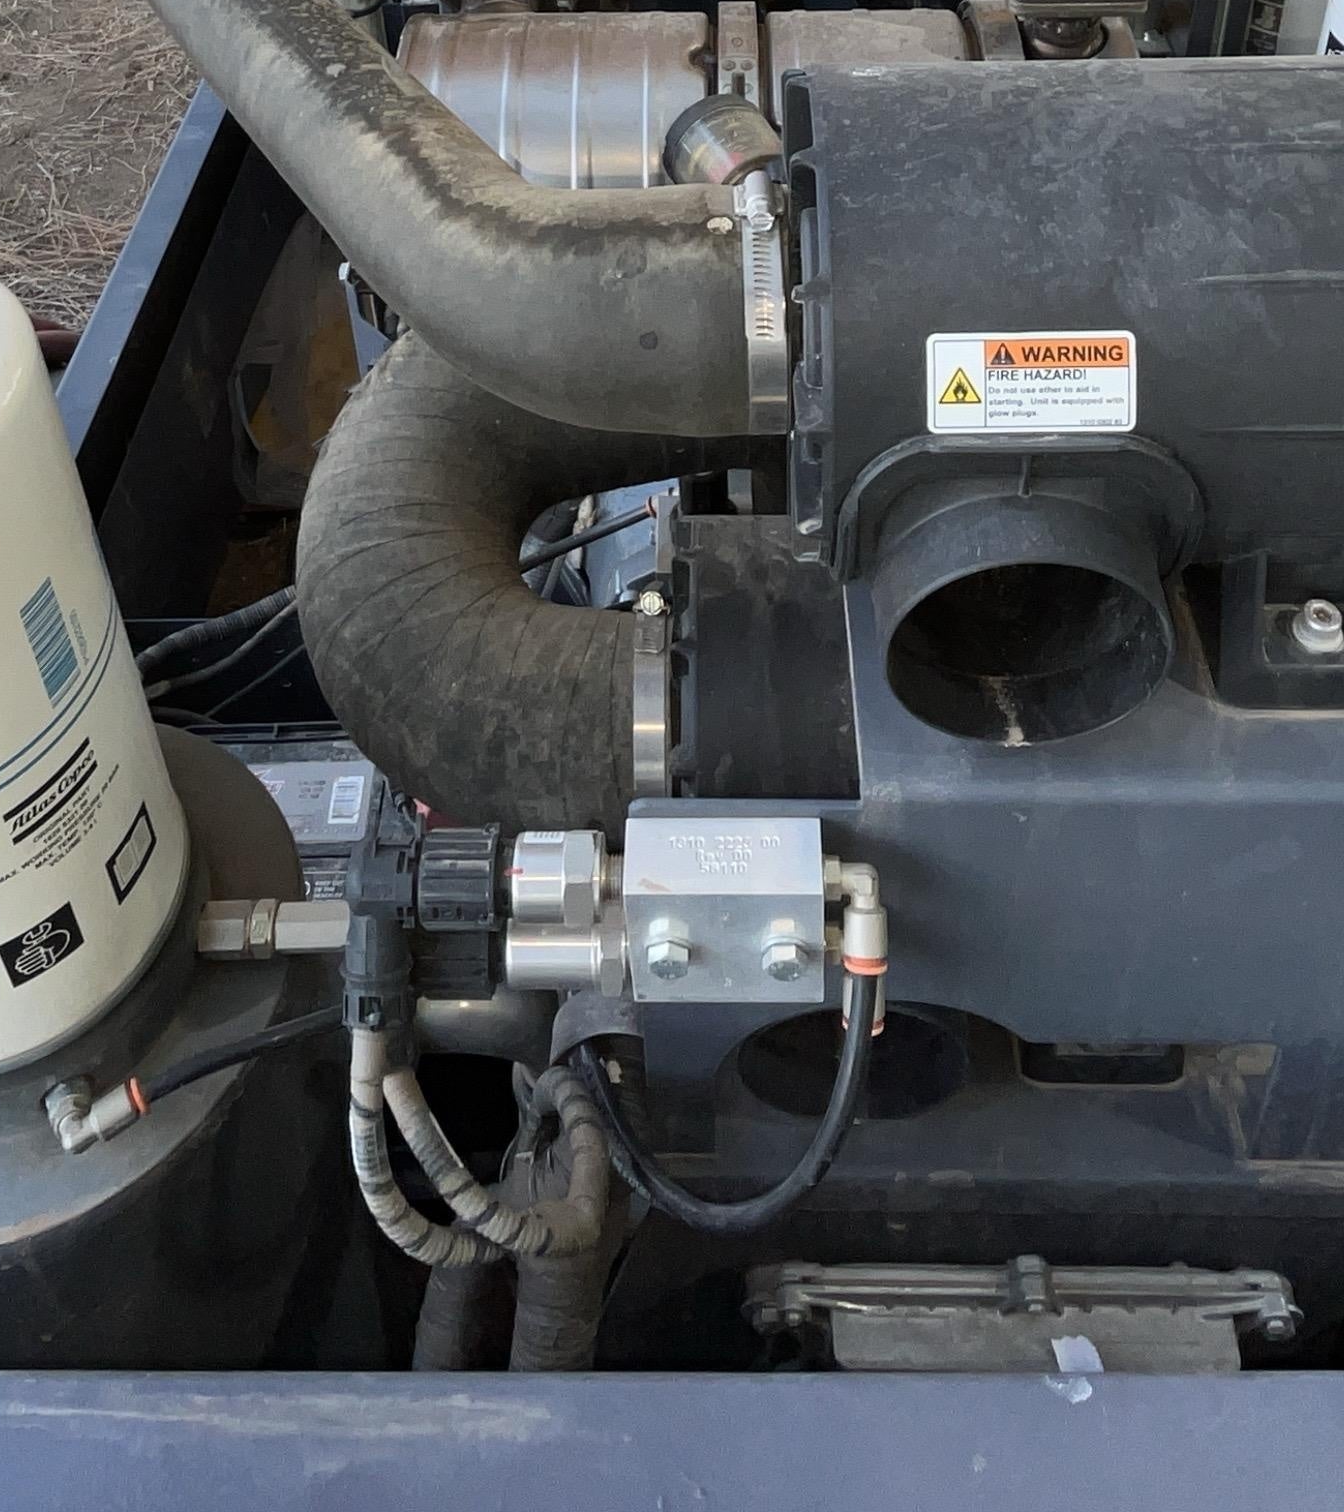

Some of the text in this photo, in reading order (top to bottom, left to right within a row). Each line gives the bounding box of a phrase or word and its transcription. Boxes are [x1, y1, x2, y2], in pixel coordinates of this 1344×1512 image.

[1021, 344, 1124, 363] WARNING
[988, 369, 1087, 381] FIRE HAZARD!
[1003, 386, 1017, 394] not
[1038, 386, 1061, 394] ether
[1031, 397, 1049, 405] Unit
[988, 410, 1009, 418] glow
[9, 793, 57, 835] Atlas
[58, 749, 95, 794] Copco
